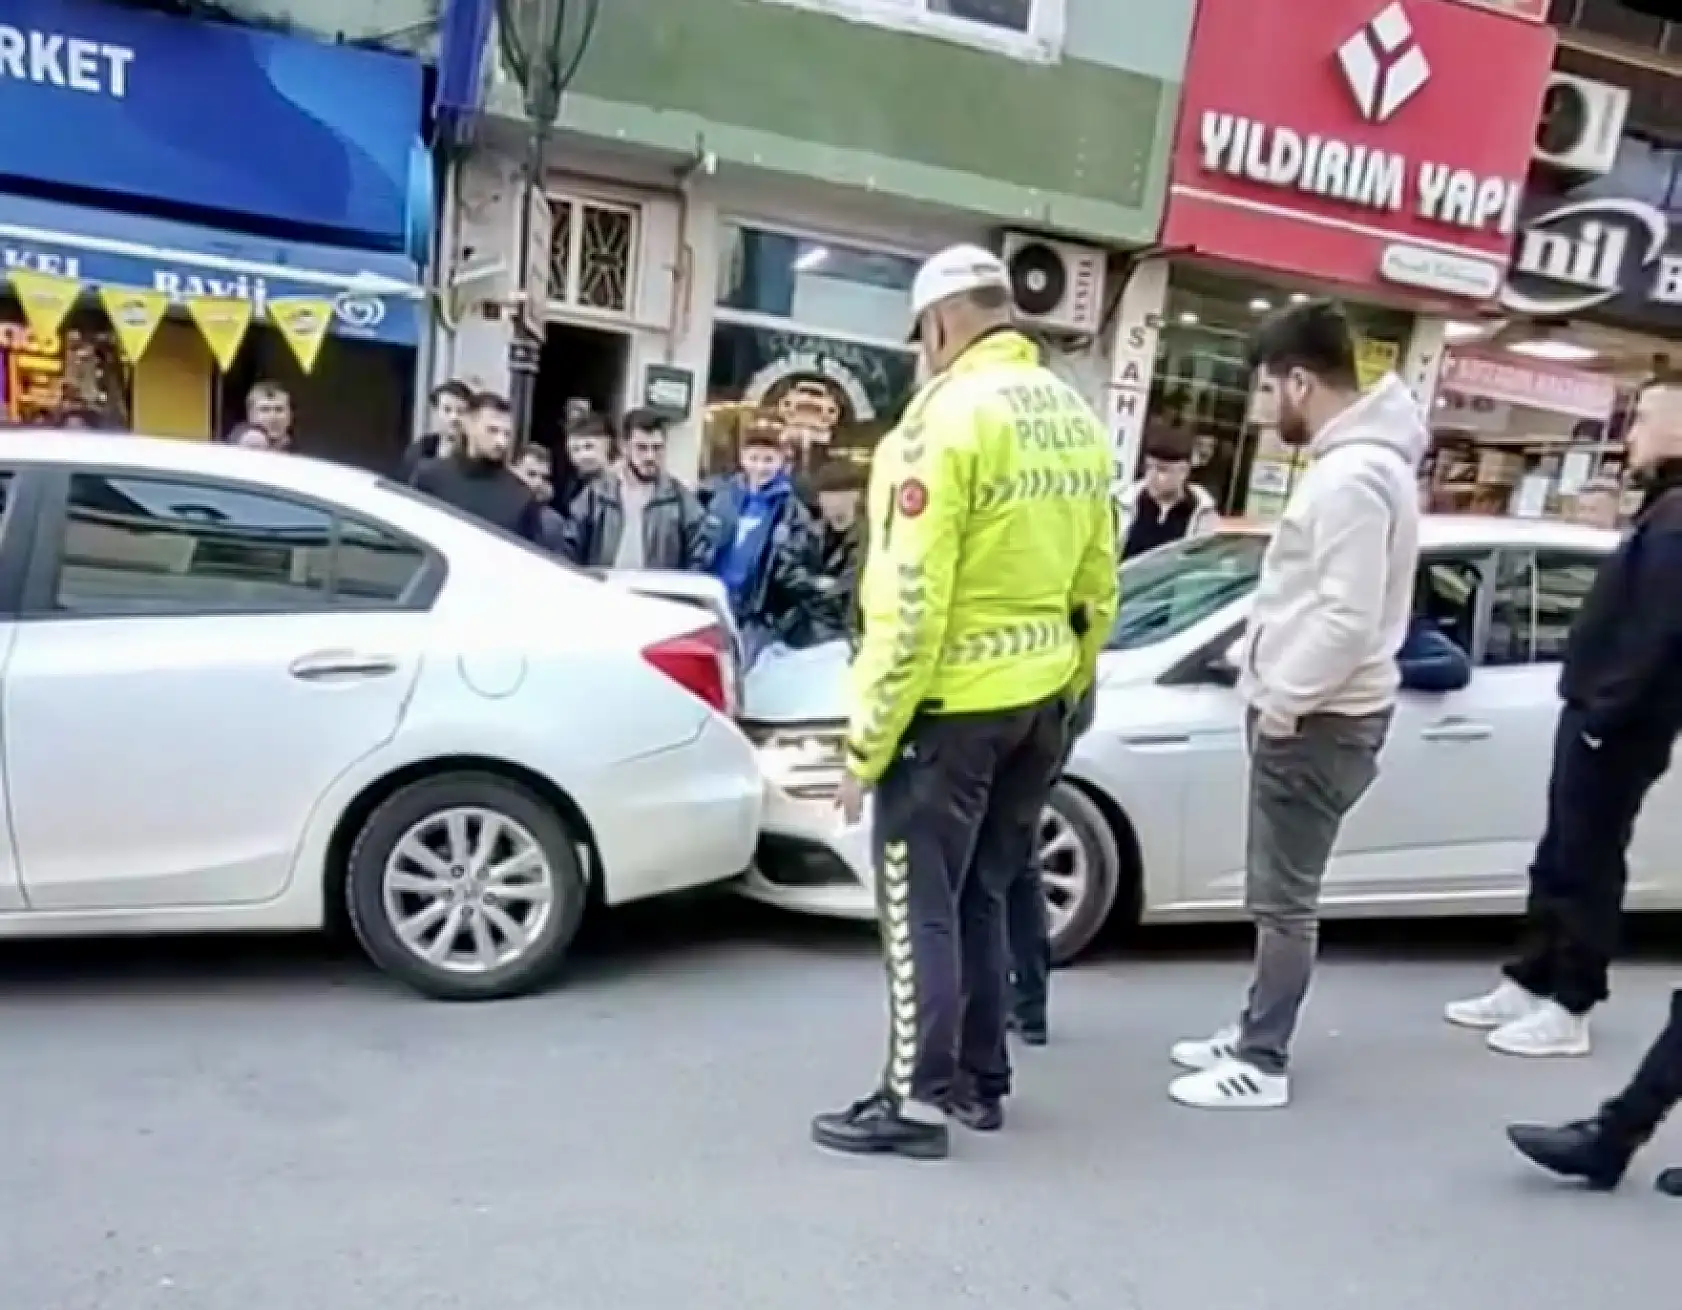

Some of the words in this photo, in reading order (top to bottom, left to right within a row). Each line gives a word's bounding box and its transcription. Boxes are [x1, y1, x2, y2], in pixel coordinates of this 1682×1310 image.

[0, 24, 136, 98] RKET
[1200, 110, 1405, 212] YILDIRIM
[1416, 160, 1518, 234] YAPI
[1516, 210, 1629, 290] nil
